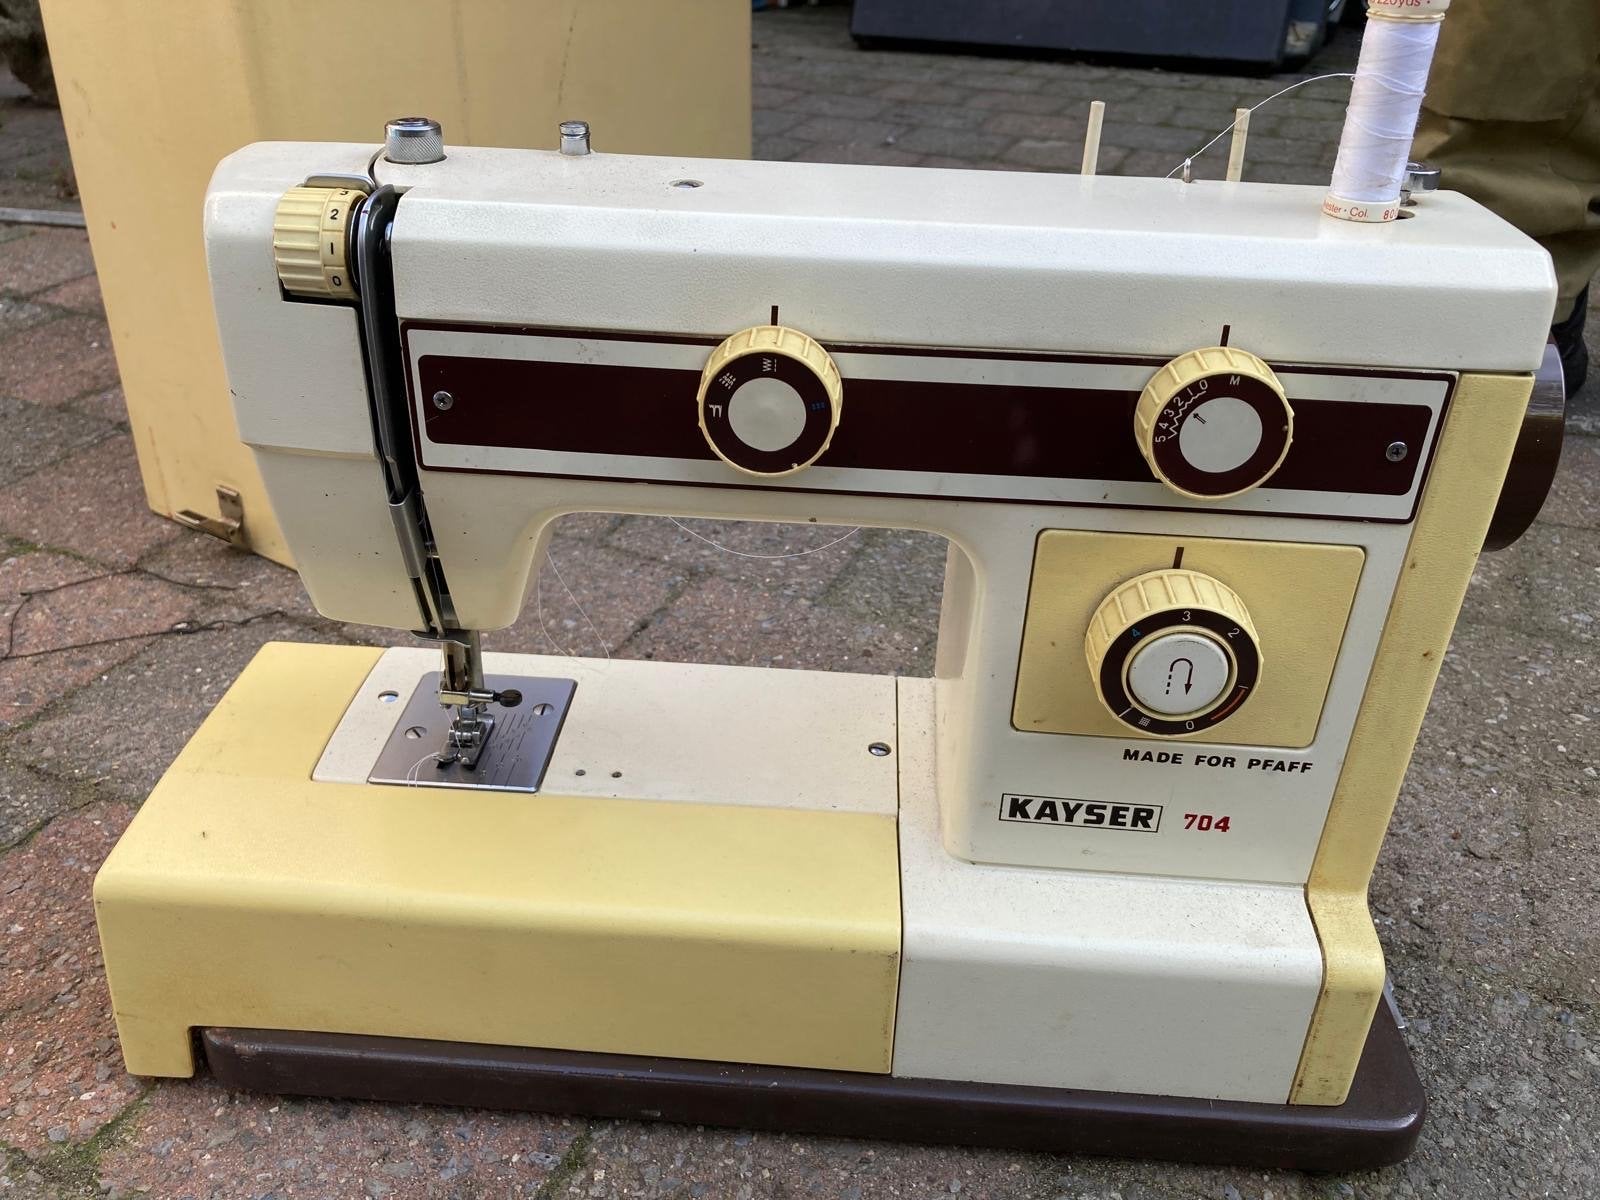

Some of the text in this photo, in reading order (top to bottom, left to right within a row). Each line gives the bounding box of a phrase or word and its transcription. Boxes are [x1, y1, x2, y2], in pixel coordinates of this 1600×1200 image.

[330, 208, 339, 220] 2
[1349, 206, 1369, 218] Col.
[330, 242, 334, 255] 1
[332, 275, 342, 287] 0
[1199, 379, 1208, 390] 0
[1229, 375, 1241, 386] M
[1173, 396, 1184, 407] 2
[1164, 408, 1175, 417] 3
[1159, 421, 1169, 430] 4
[1155, 435, 1166, 443] 5
[1131, 628, 1141, 638] 4
[1182, 610, 1191, 621] 3
[1227, 627, 1240, 638] 2
[1185, 720, 1195, 730] 0
[1122, 748, 1313, 774] MADE FOR PFAFF
[1008, 797, 1154, 829] KAYSER
[1183, 813, 1231, 833] 704
